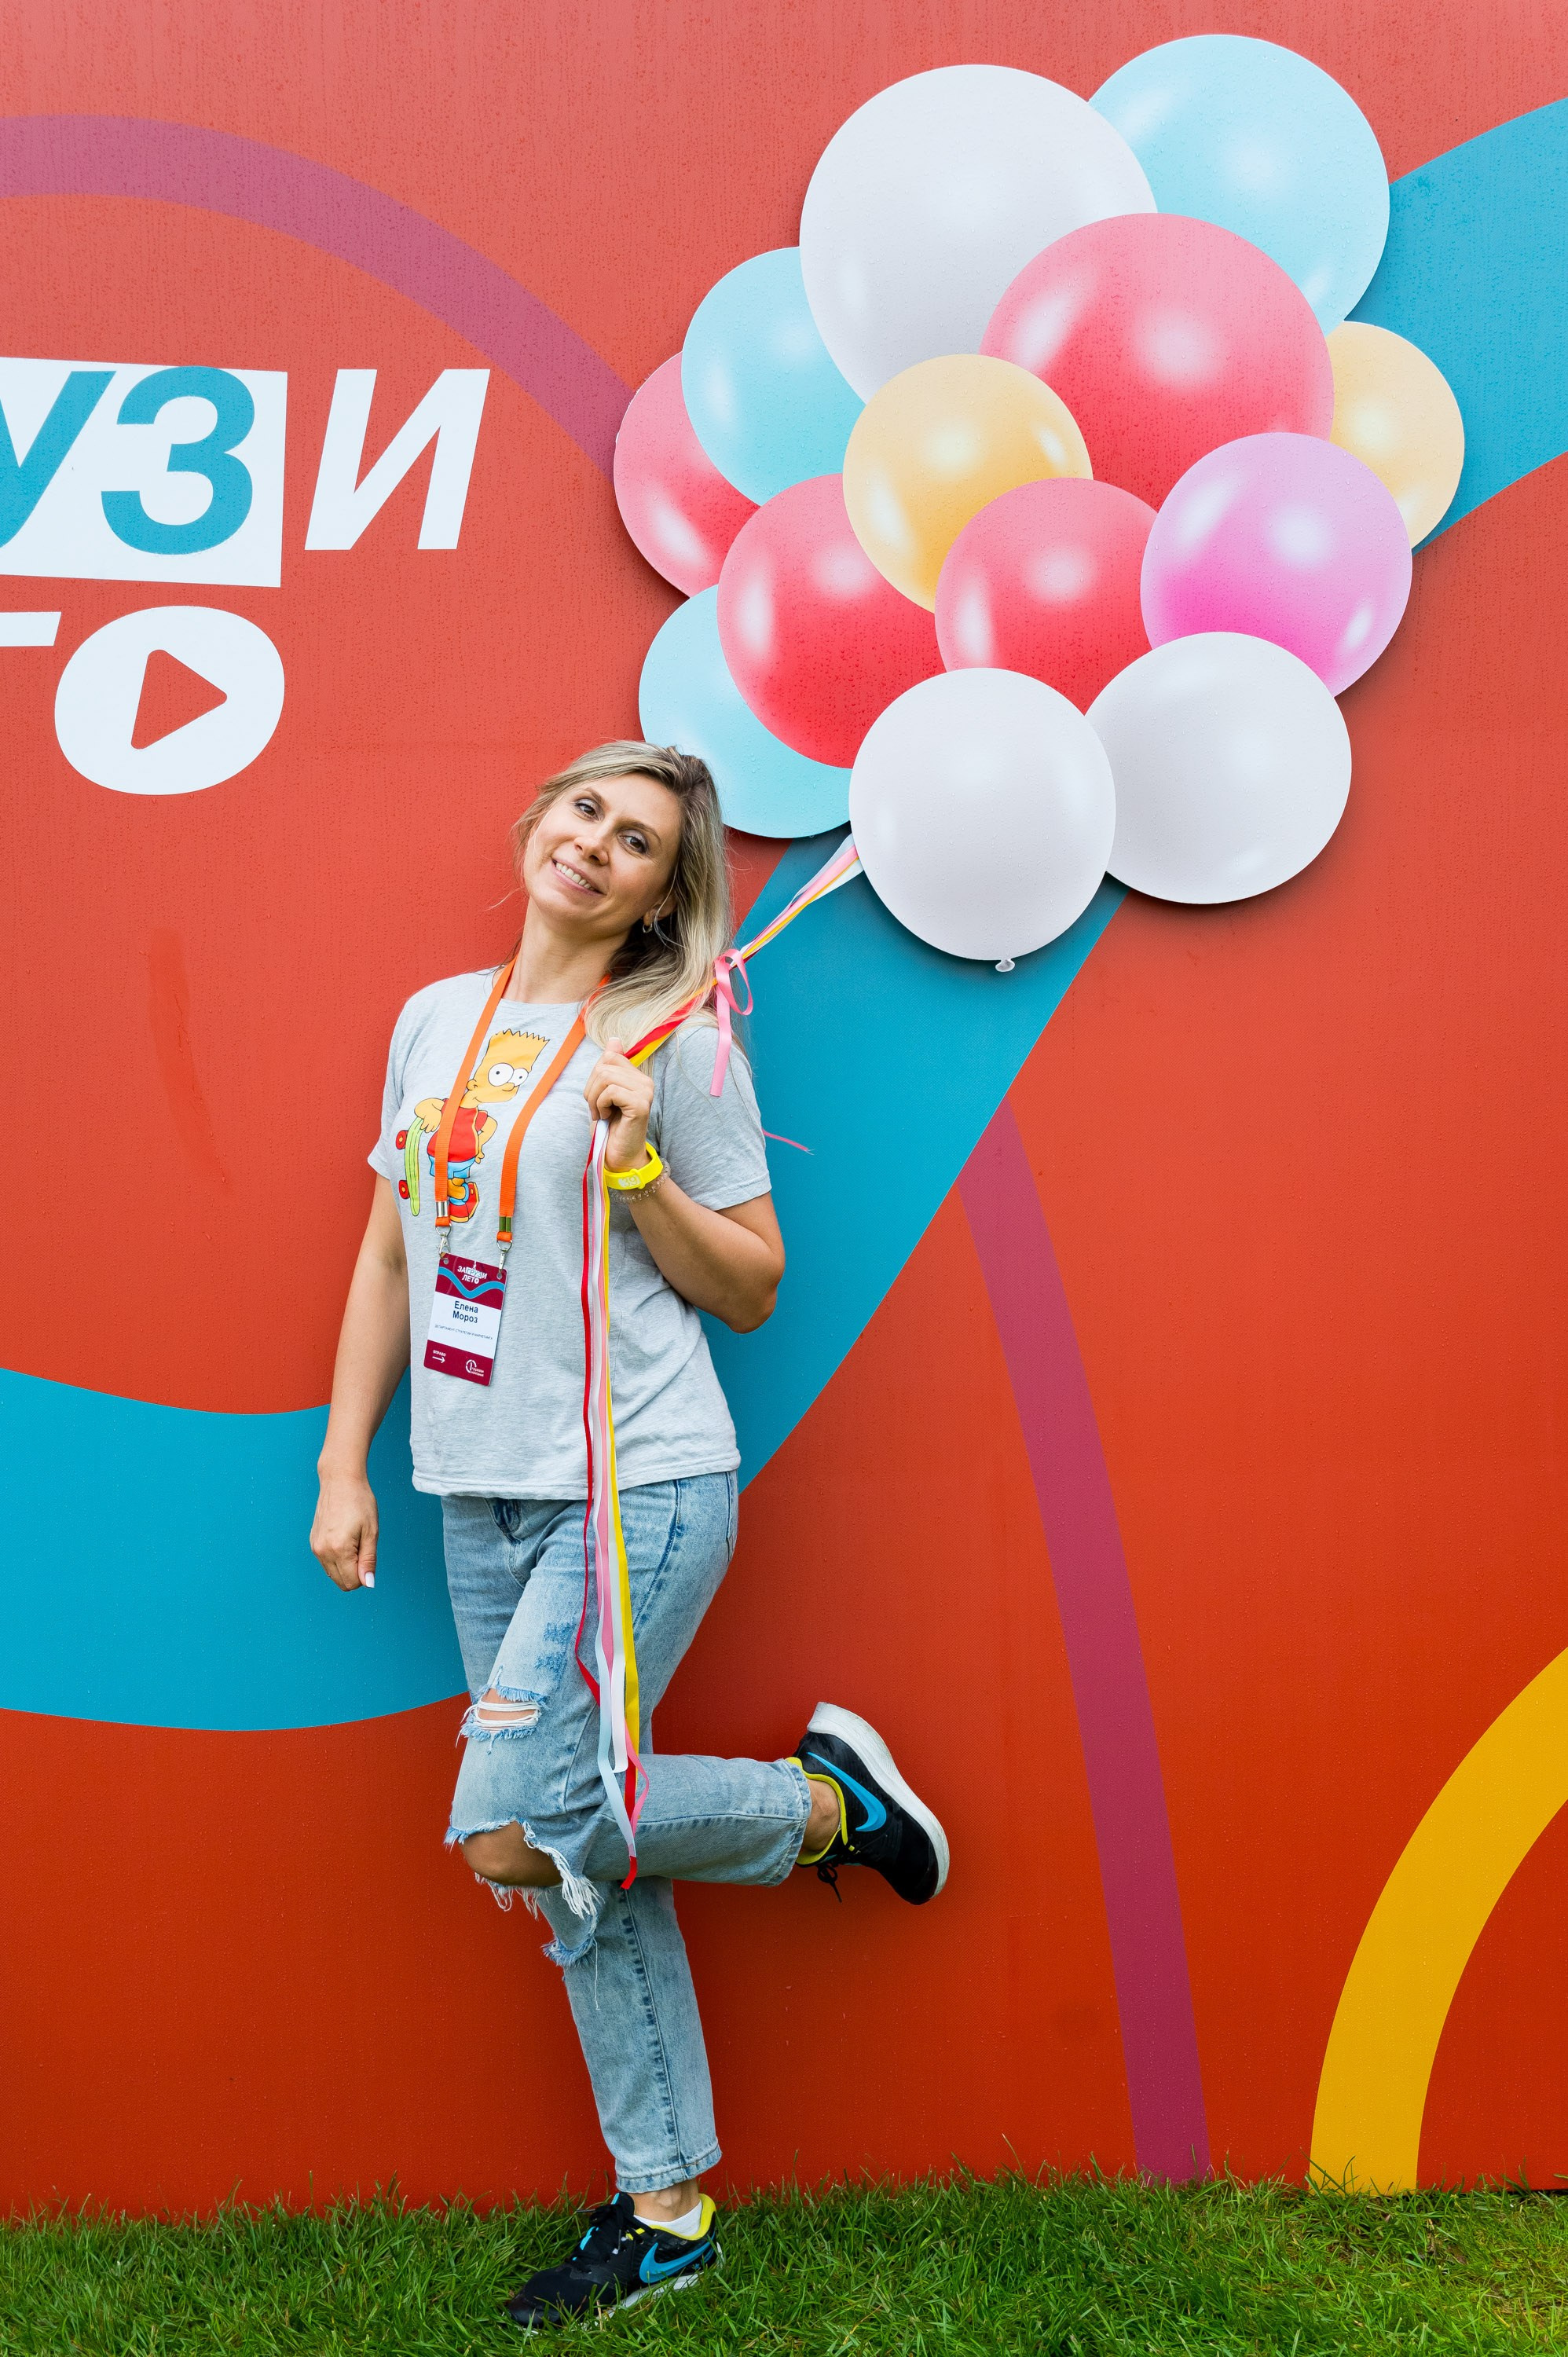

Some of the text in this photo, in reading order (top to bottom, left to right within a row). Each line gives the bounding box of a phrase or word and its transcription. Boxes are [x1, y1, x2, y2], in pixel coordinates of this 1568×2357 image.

[457, 1266, 487, 1280] ЗАГРУЗИ
[462, 1274, 480, 1285] ЛЕТО
[454, 1300, 478, 1314] Елена
[452, 1310, 478, 1323] Мороз
